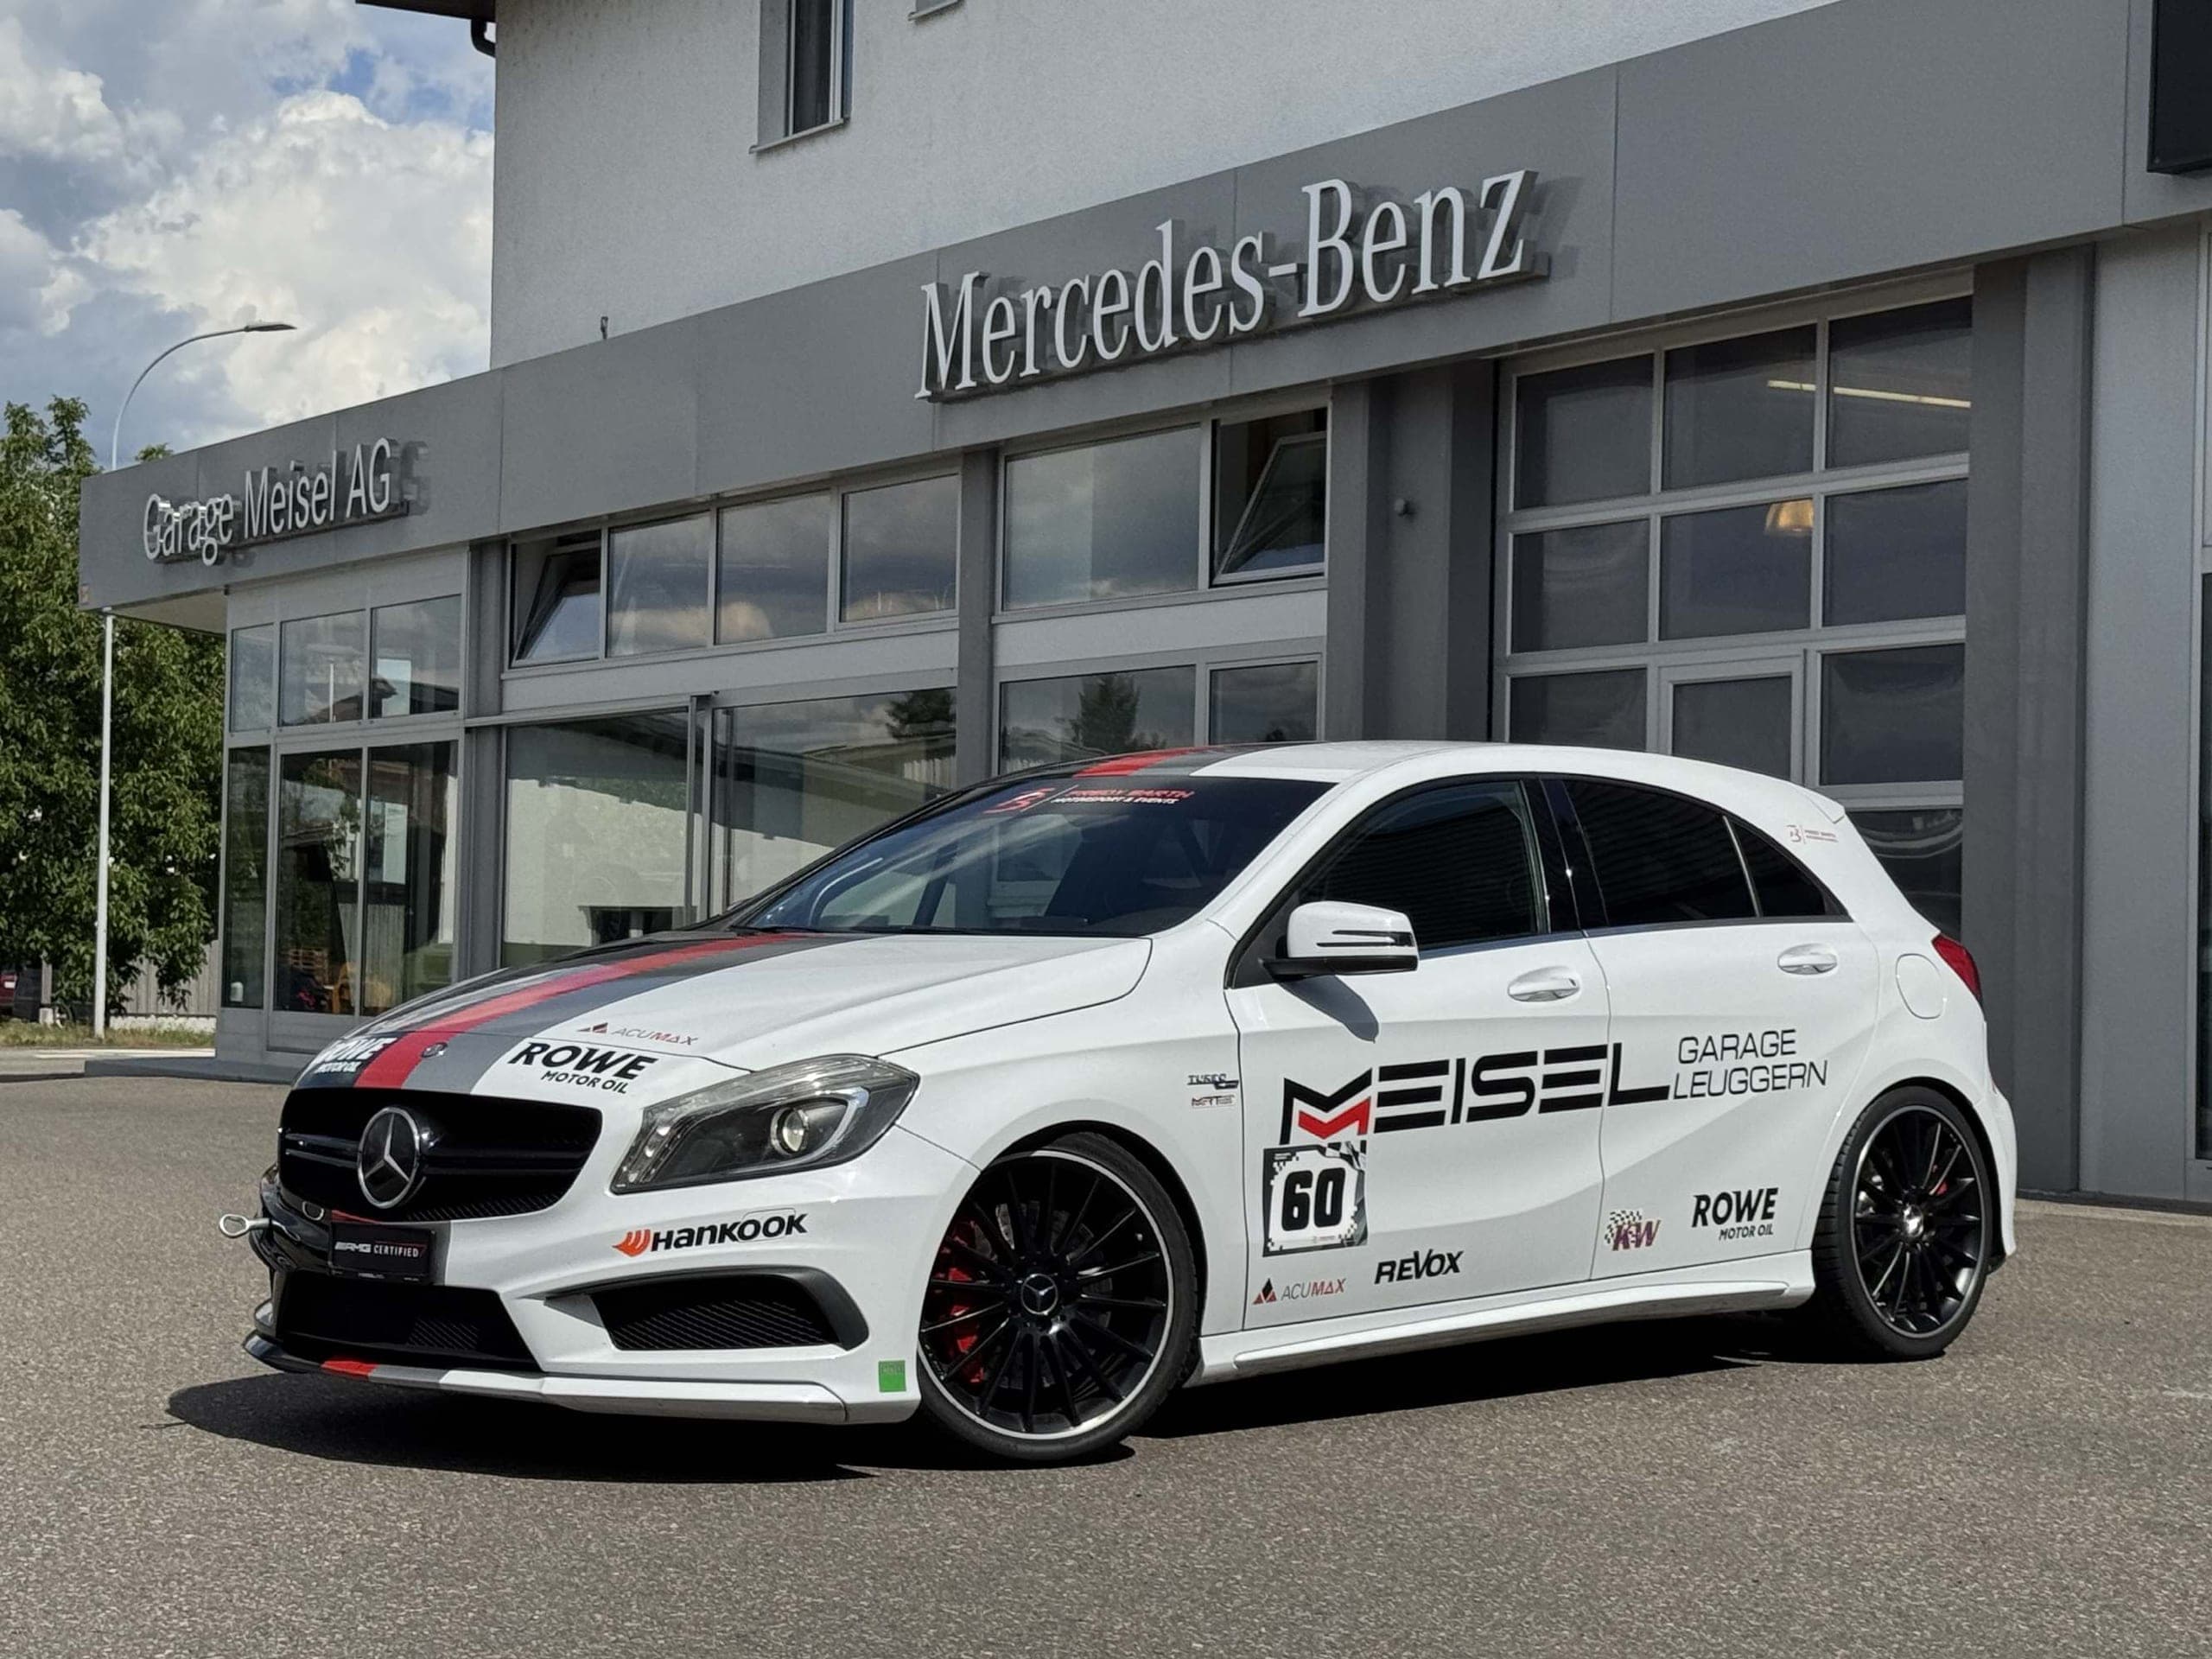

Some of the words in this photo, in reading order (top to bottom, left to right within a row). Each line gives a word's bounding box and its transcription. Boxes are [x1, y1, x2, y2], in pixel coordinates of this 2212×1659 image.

[916, 169, 1530, 398] Mercedes-Benz
[143, 493, 235, 566] Garage
[244, 449, 337, 539] Meisel
[346, 437, 391, 518] AG
[508, 1042, 659, 1080] ROWE
[1678, 1029, 1796, 1064] GARAGE
[541, 1071, 601, 1089] MOTOR
[601, 1079, 629, 1094] OIL
[1280, 1042, 1670, 1146] MEISEL
[1673, 1060, 1828, 1101] LEUGGERN
[1281, 1167, 1346, 1231] 60
[1691, 1187, 1779, 1228] ROWE
[373, 1244, 419, 1257] CERTIFIED
[1719, 1226, 1756, 1241] MOTOR
[1757, 1224, 1774, 1236] OIL
